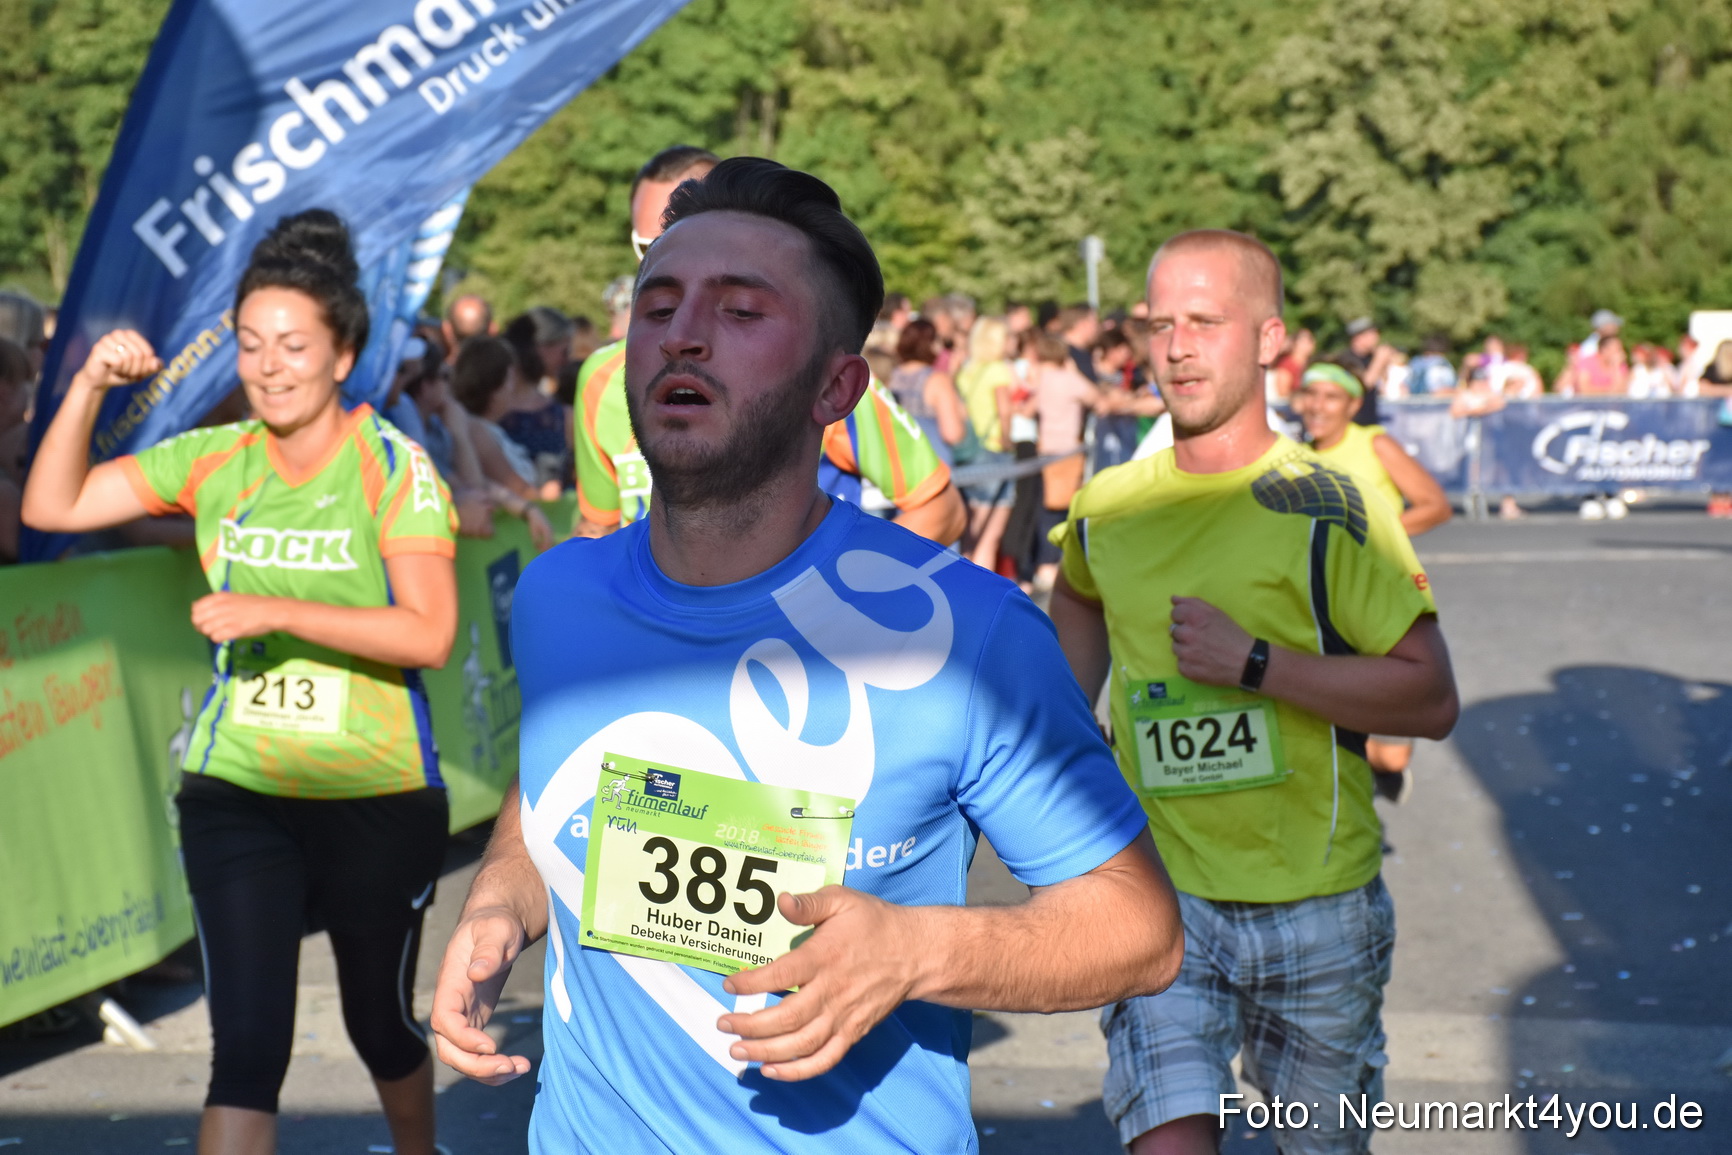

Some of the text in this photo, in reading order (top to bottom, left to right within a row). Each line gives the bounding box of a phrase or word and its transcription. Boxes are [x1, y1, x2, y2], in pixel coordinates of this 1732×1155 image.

[418, 22, 527, 115] Druck
[133, 0, 498, 278] Frischma
[1550, 411, 1711, 470] Fischer
[217, 518, 359, 571] BOCK
[250, 673, 315, 711] 213
[1146, 712, 1258, 763] 1624
[1163, 757, 1243, 777] Bayer Michael
[626, 806, 661, 818] neumarkt
[627, 789, 709, 820] firmenlauf
[714, 823, 760, 845] 2018
[846, 836, 916, 871] dere
[638, 836, 779, 926] 385
[630, 924, 774, 965] Debeka Versicherungen
[646, 907, 763, 948] Huber Daniel
[712, 960, 740, 971] Frischmann
